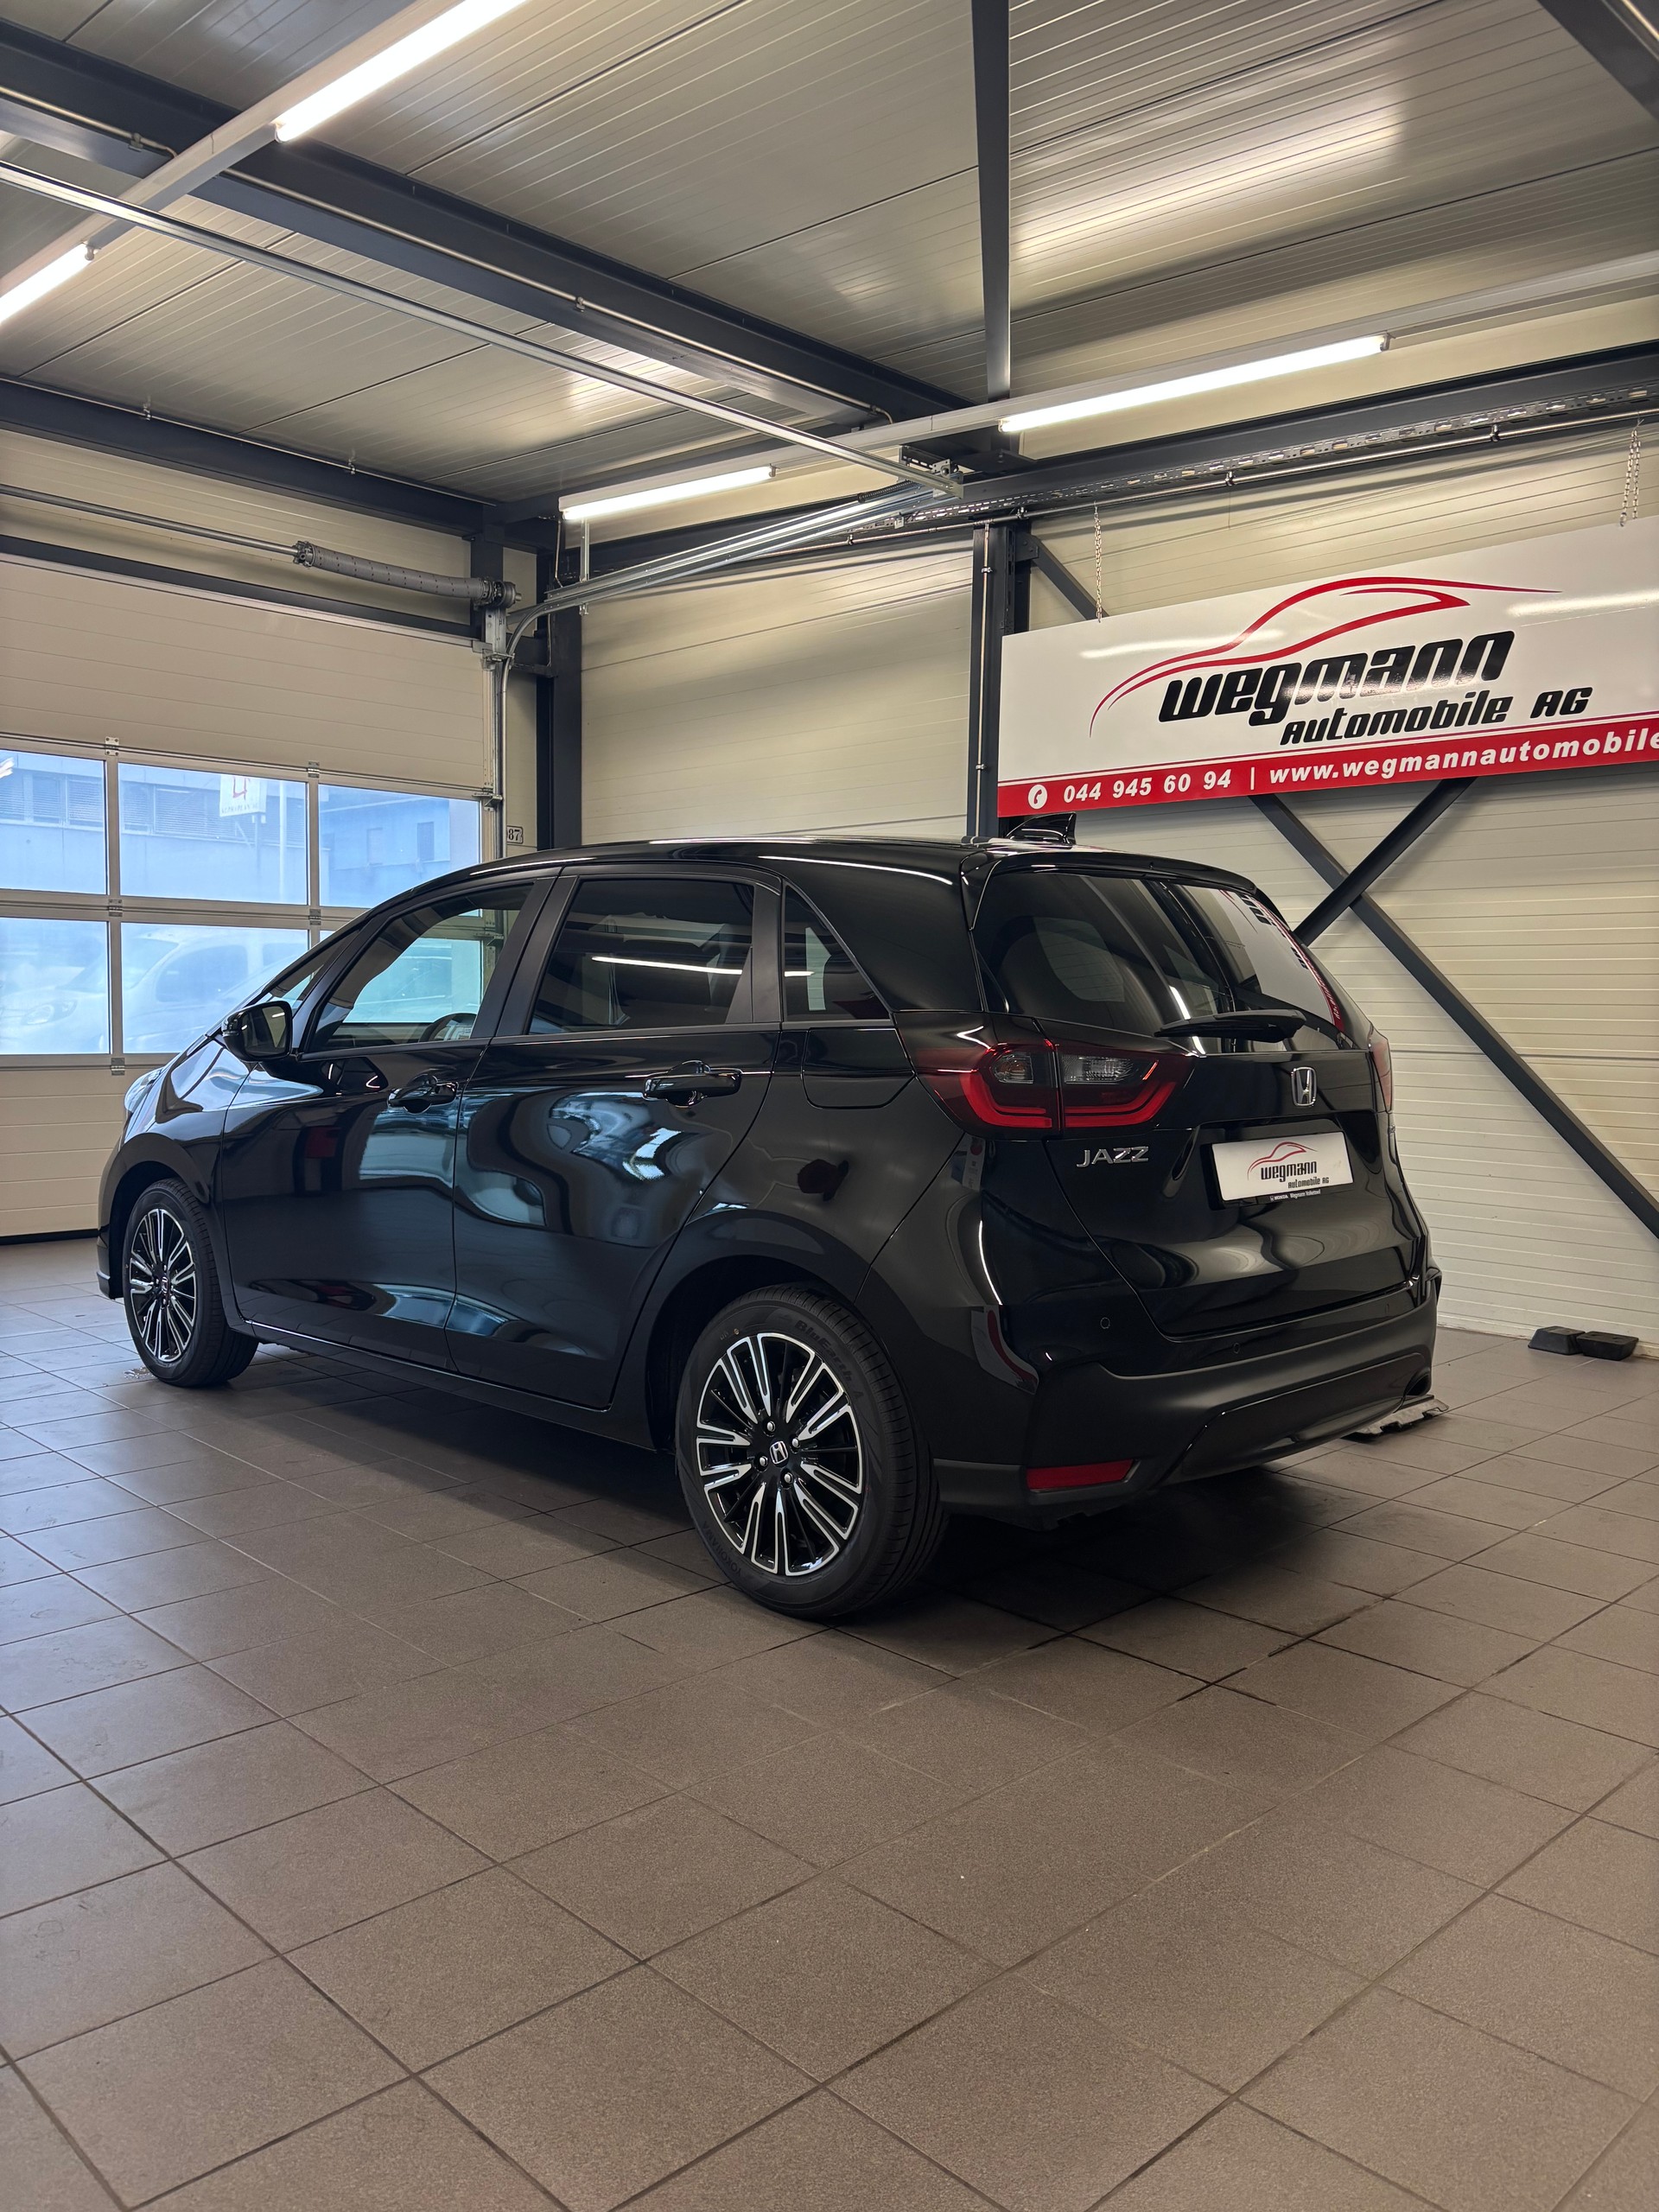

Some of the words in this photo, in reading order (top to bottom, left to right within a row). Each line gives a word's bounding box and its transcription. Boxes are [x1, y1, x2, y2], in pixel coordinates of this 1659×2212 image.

[1158, 630, 1516, 727] wegmann
[1529, 686, 1593, 719] AG
[1063, 782, 1102, 804] 044
[1112, 777, 1153, 799] 945
[1163, 772, 1192, 794] 60
[1203, 768, 1232, 791] 94
[508, 828, 520, 841] 87
[1076, 1146, 1149, 1168] JAZZ
[1260, 1161, 1318, 1183] wegmann
